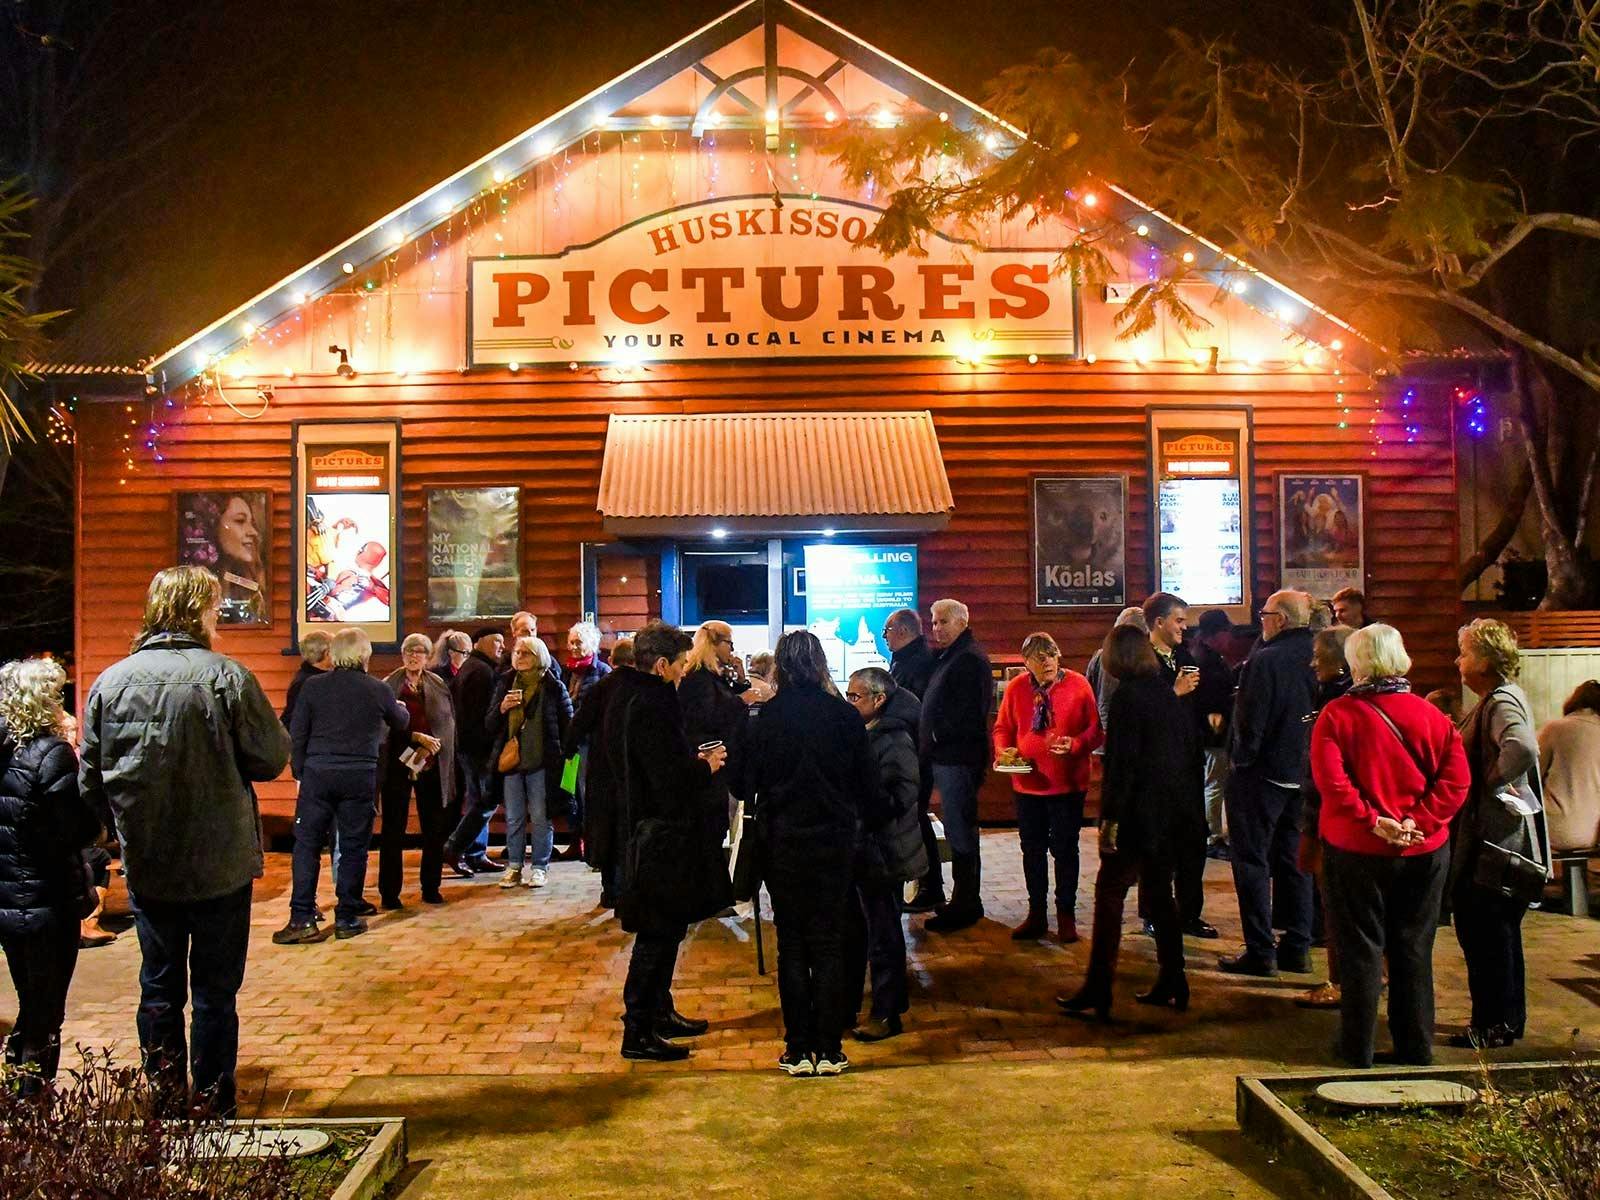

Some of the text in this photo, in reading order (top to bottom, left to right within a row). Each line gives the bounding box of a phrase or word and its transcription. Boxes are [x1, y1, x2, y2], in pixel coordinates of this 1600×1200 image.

[647, 208, 880, 256] HUSKISSO
[492, 263, 1050, 327] PICTURES
[603, 329, 946, 348] YOUR LOCAL CINEMA
[1166, 443, 1232, 451] PICTURES
[314, 457, 382, 466] PICTURES
[432, 533, 451, 542] MY
[432, 543, 495, 554] NATIONAL
[1045, 564, 1116, 588] Koalas
